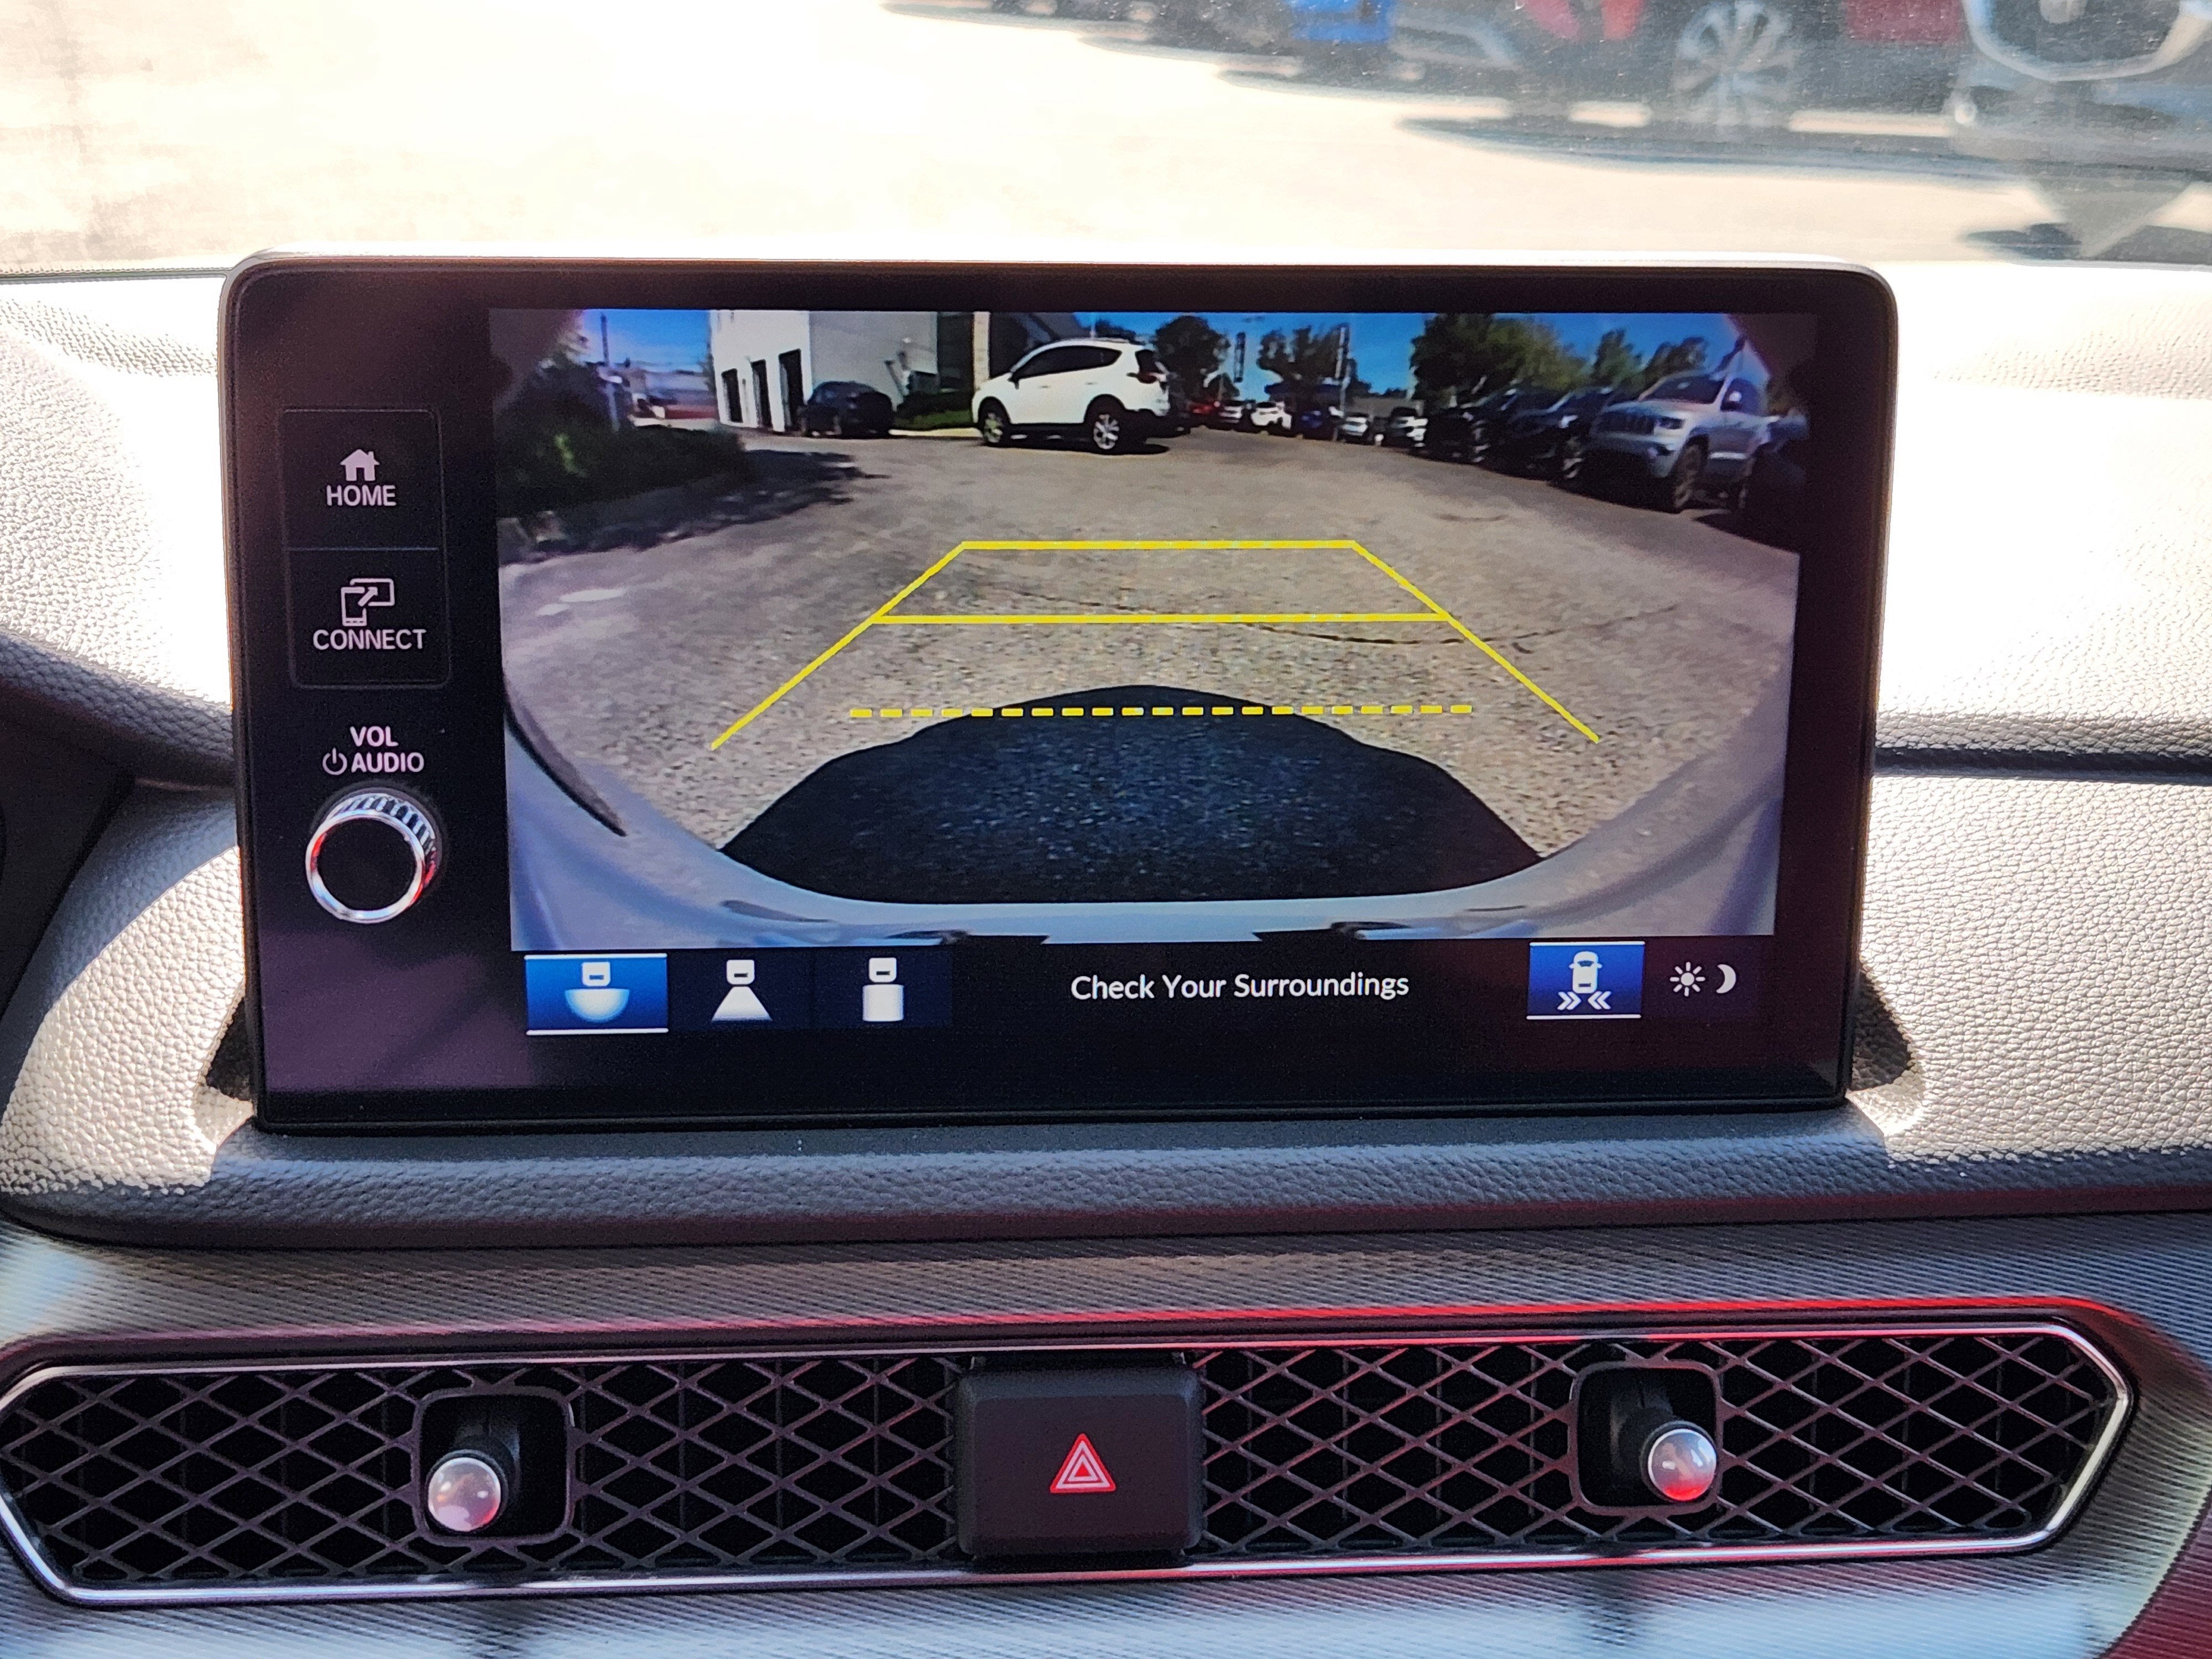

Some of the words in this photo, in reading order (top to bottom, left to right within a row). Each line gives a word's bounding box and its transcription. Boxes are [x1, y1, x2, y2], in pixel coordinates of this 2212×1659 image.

[326, 484, 397, 506] HOME
[313, 629, 426, 650] CONNECT
[349, 726, 399, 747] VOL
[351, 752, 424, 773] AUDIO
[1071, 974, 1155, 1000] Check
[1162, 974, 1227, 999] Your
[1234, 971, 1409, 1000] Surroundings
